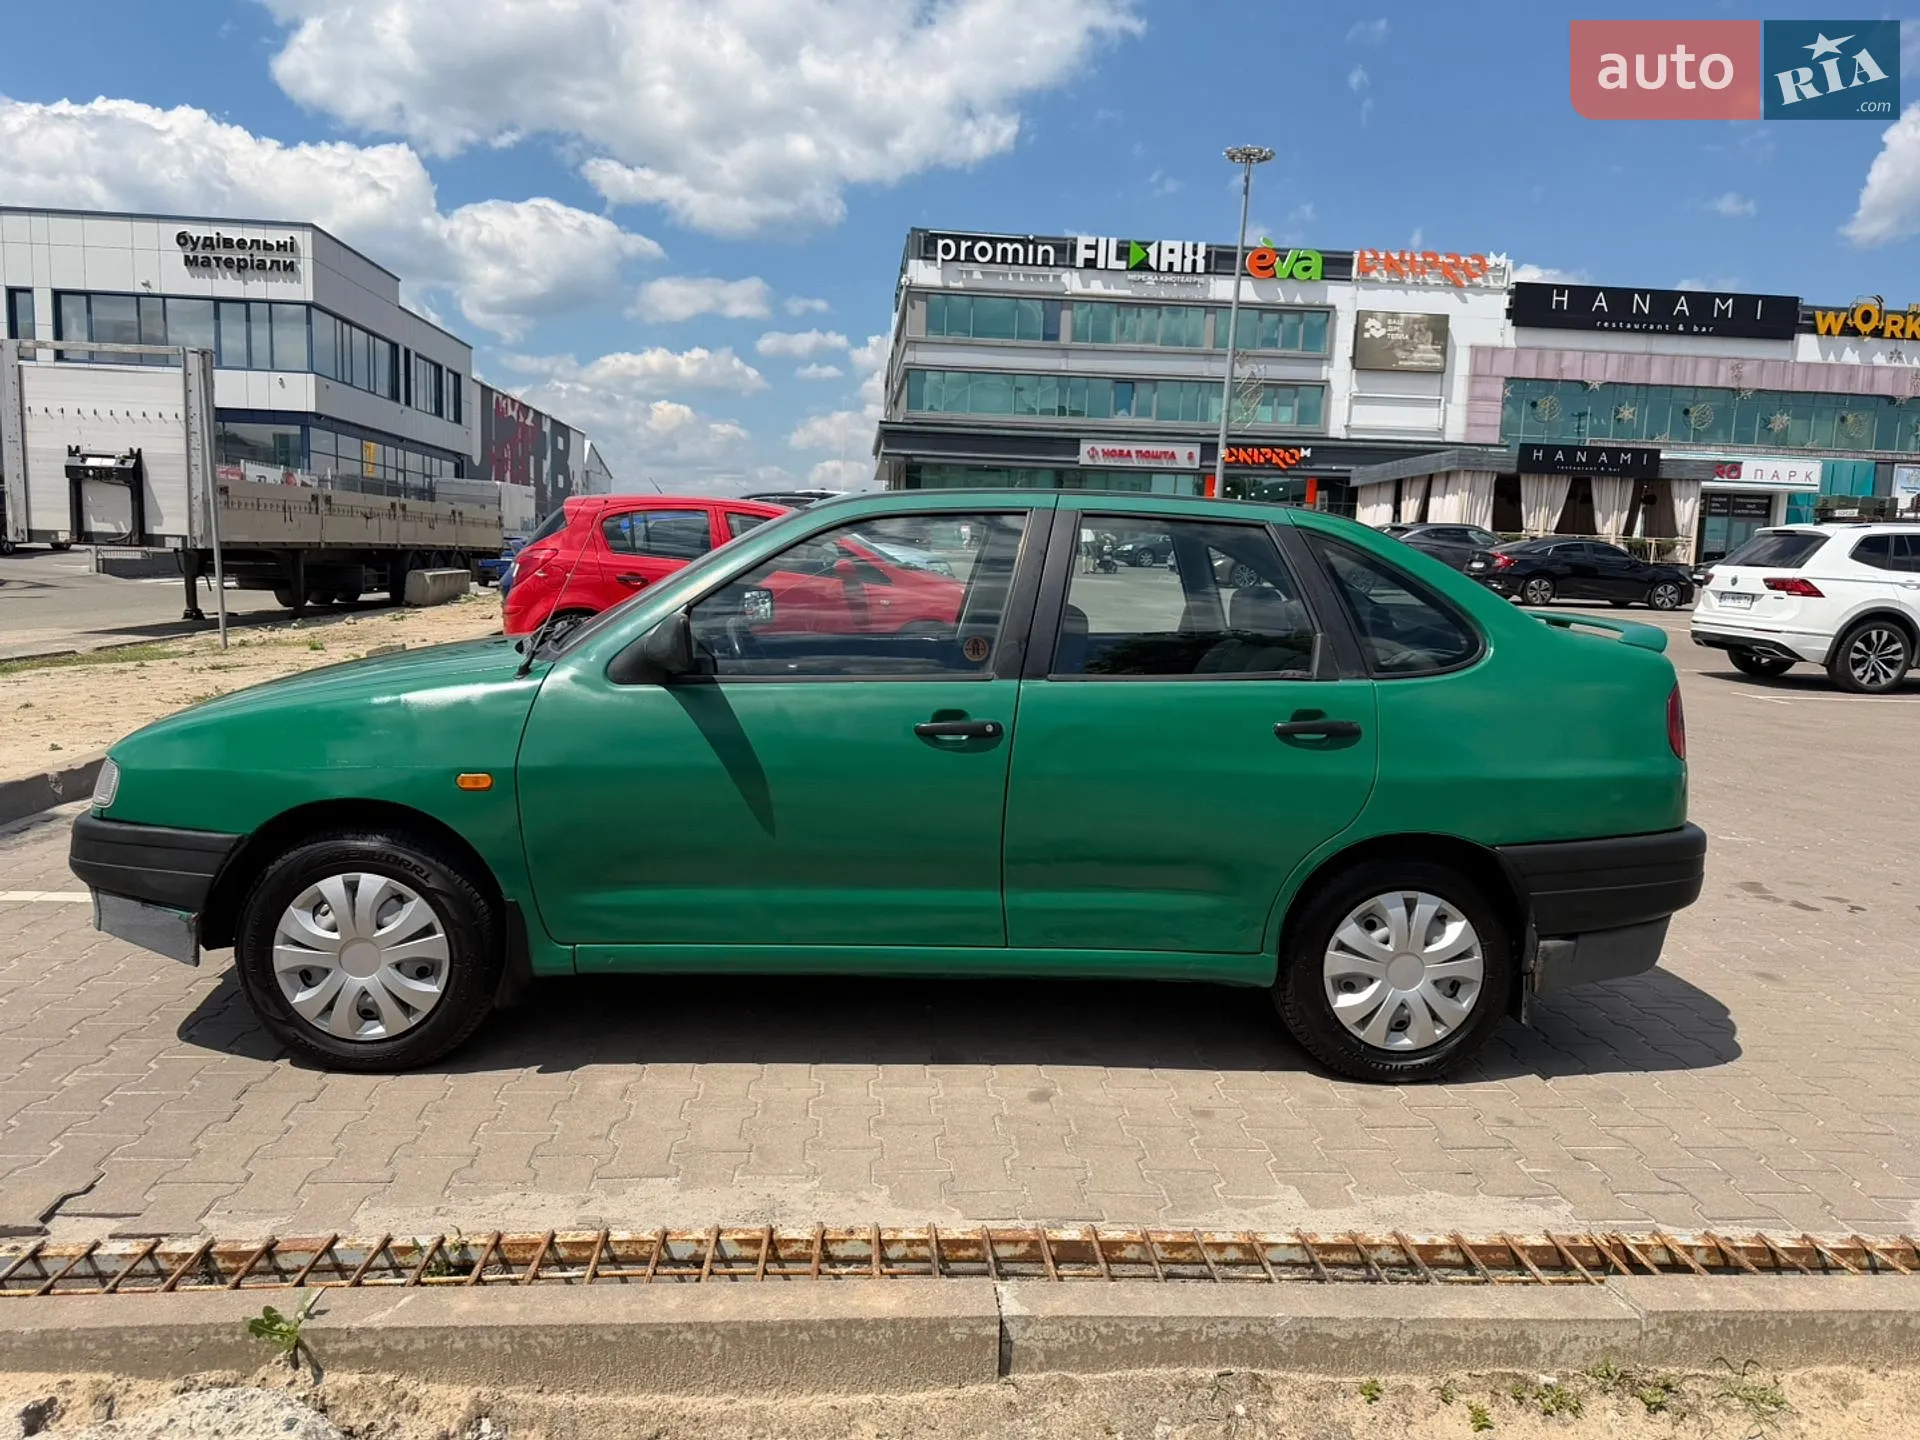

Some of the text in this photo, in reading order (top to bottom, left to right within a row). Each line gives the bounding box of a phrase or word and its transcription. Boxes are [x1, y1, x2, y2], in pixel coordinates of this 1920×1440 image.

[175, 230, 296, 253] будівельні
[936, 234, 1056, 268] promin
[183, 253, 296, 274] матеріали
[1357, 246, 1489, 288] DNIPRO
[1550, 289, 1764, 321] HANAMI
[1596, 320, 1670, 332] restaurant
[1692, 323, 1715, 333] bar
[1101, 448, 1177, 461] НОВА ПОШТА
[1223, 447, 1300, 469] DNIPRO
[1532, 449, 1648, 465] HANAMI
[1753, 468, 1814, 482] ПАРК
